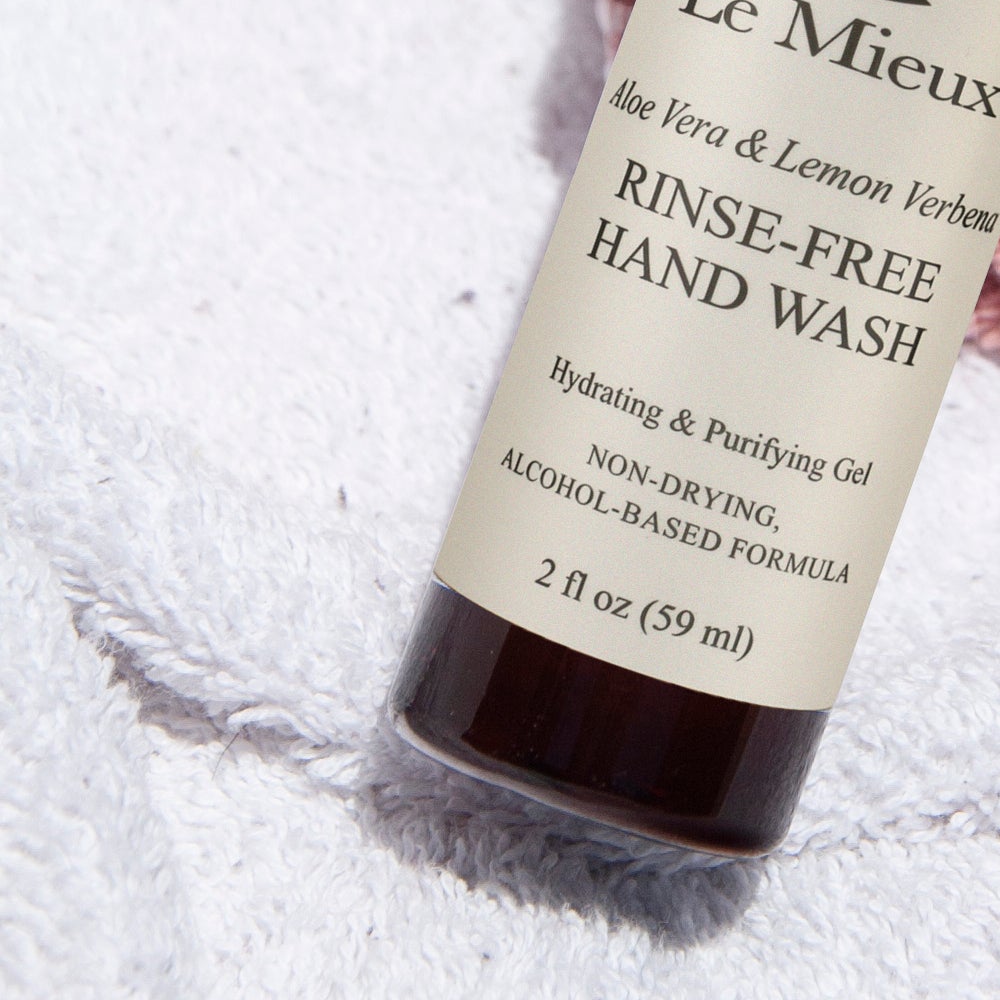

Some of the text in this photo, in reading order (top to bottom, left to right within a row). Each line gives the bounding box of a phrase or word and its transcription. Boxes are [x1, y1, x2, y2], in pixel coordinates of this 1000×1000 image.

[609, 77, 999, 233] Aloe Vera & Lemon Verbena
[587, 218, 926, 367] HAND WASH
[615, 158, 941, 303] RINSE-FREE
[550, 356, 873, 486] Hydrating & Purifying Gel
[586, 444, 780, 533] NON-DRYING,
[500, 447, 850, 584] ALCOHOL-BASED FORMULA
[534, 558, 755, 662] 2 fl oz (59 ml)
